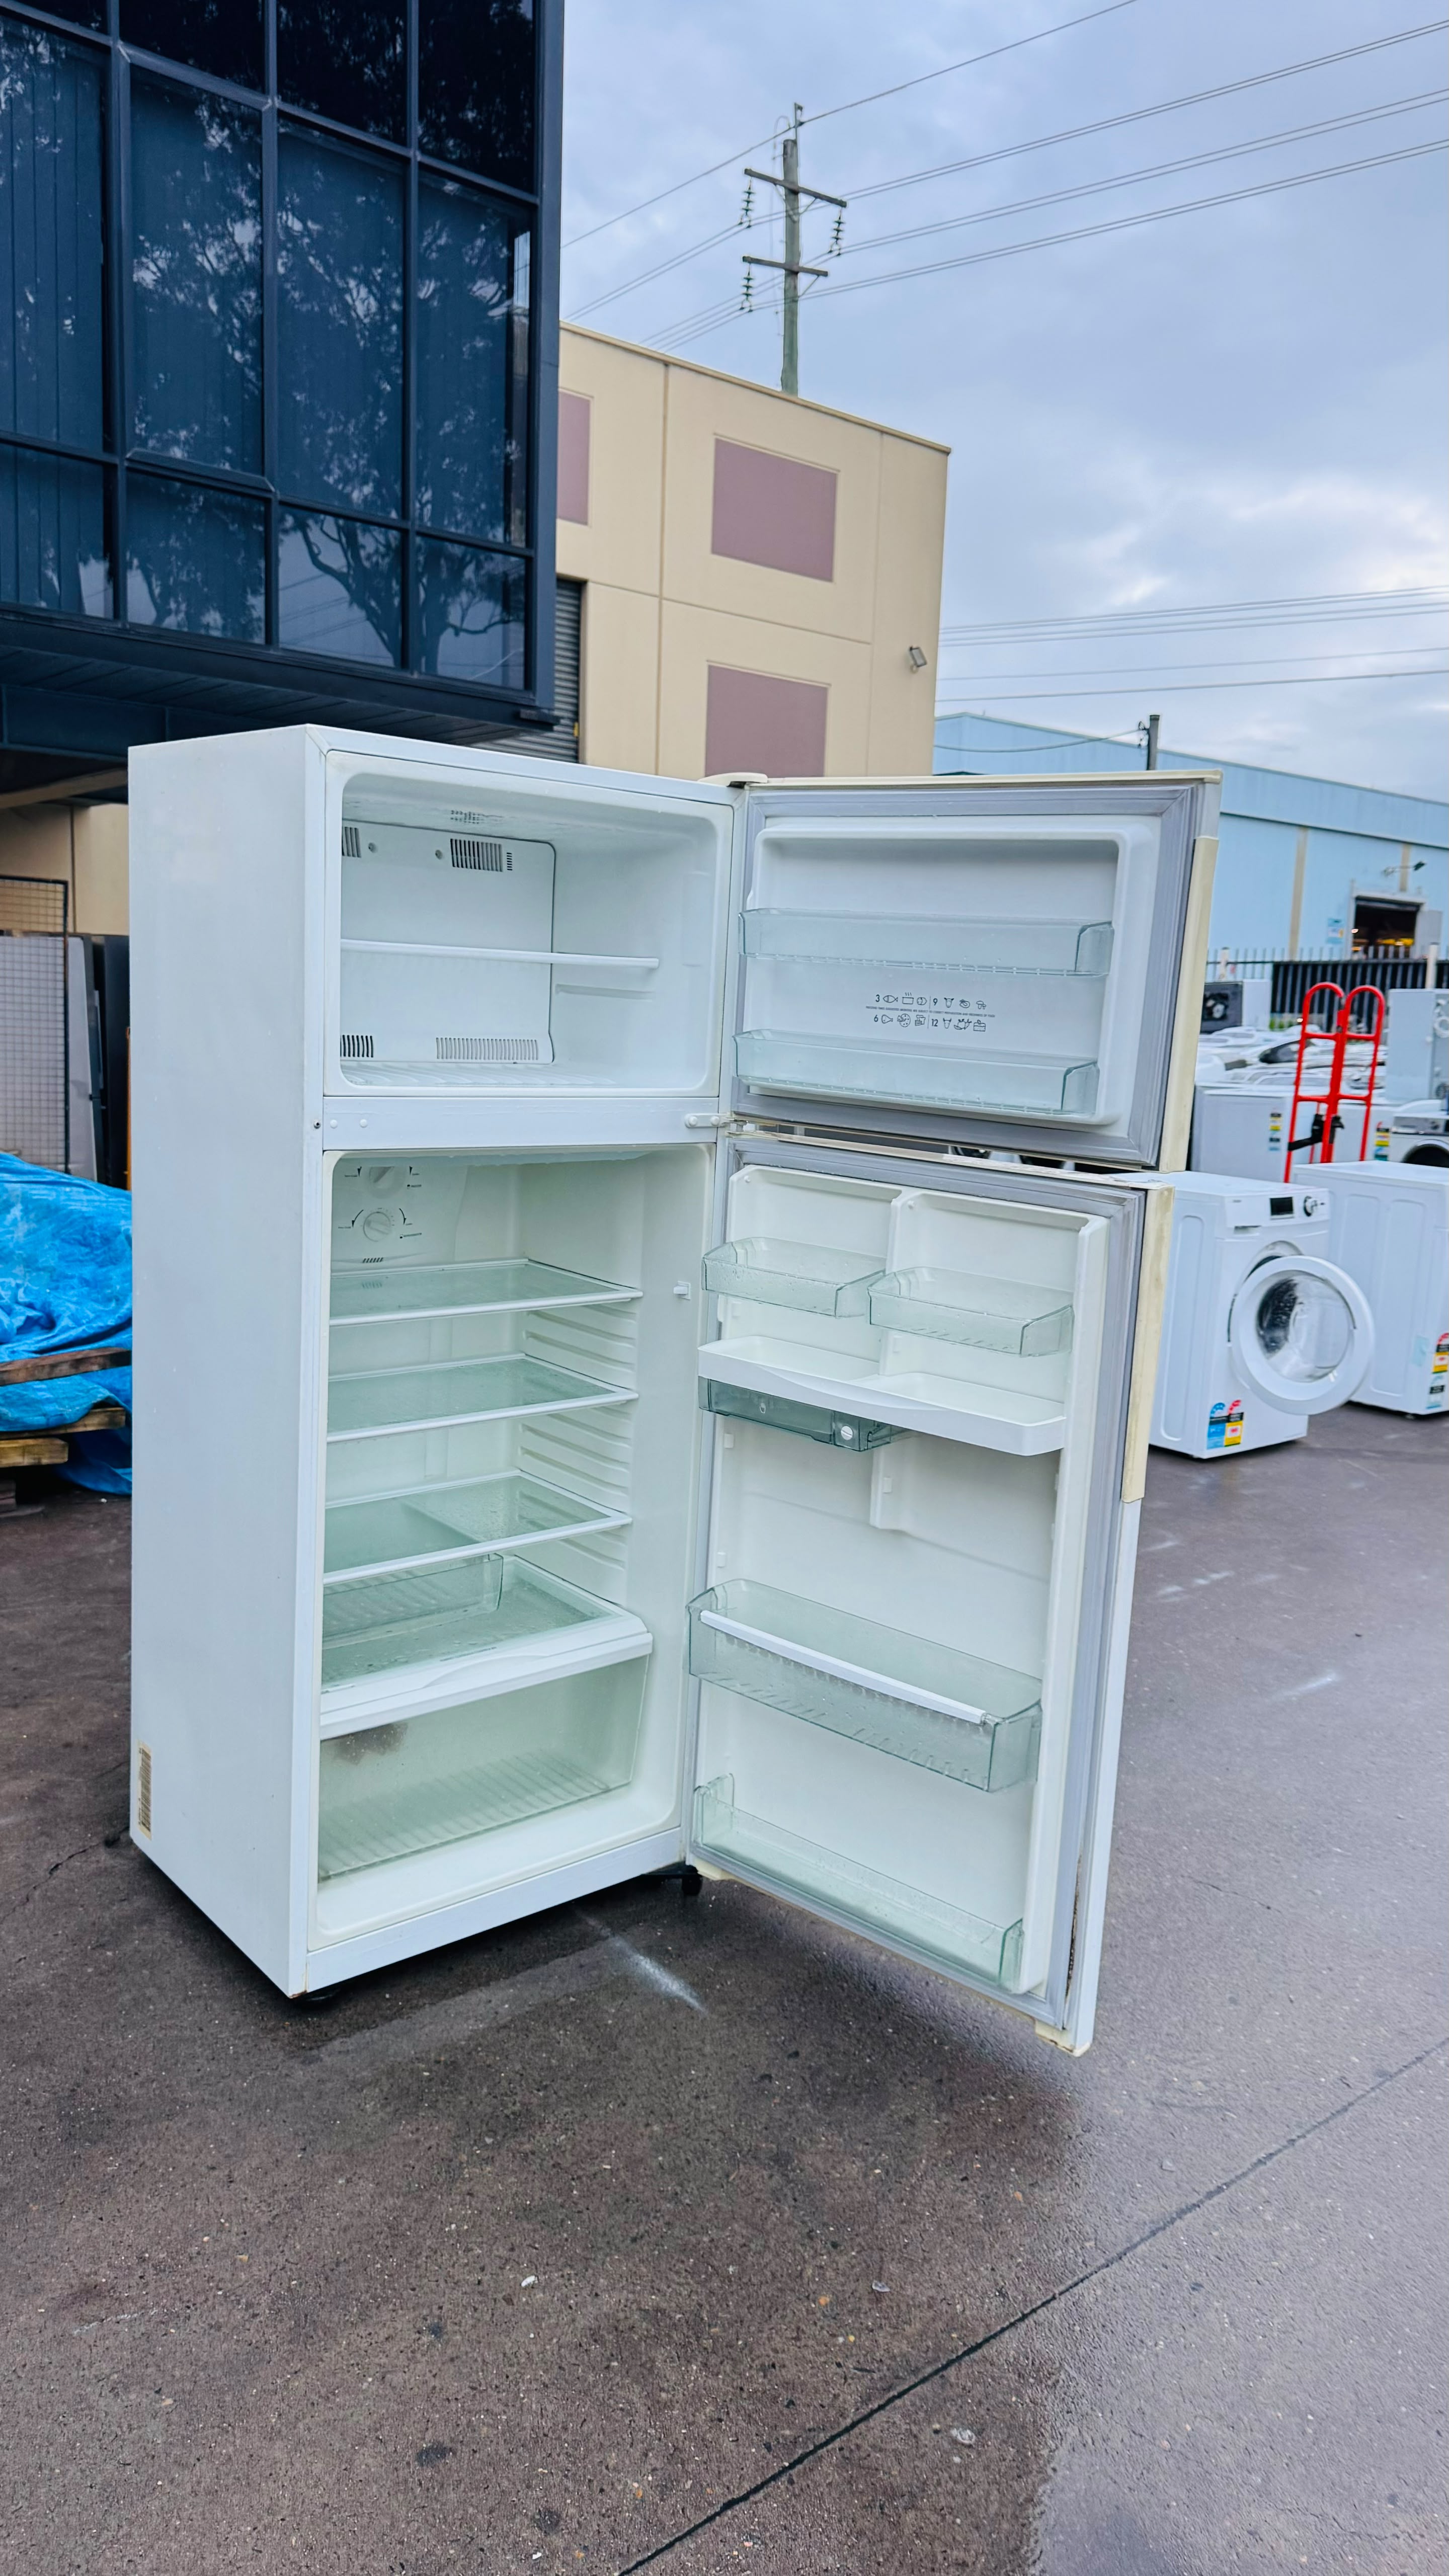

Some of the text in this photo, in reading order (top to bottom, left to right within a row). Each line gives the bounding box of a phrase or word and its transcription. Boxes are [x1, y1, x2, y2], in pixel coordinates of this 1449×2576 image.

[875, 994, 880, 1002] 3
[874, 1014, 878, 1022] 6
[931, 1018, 938, 1026] 12
